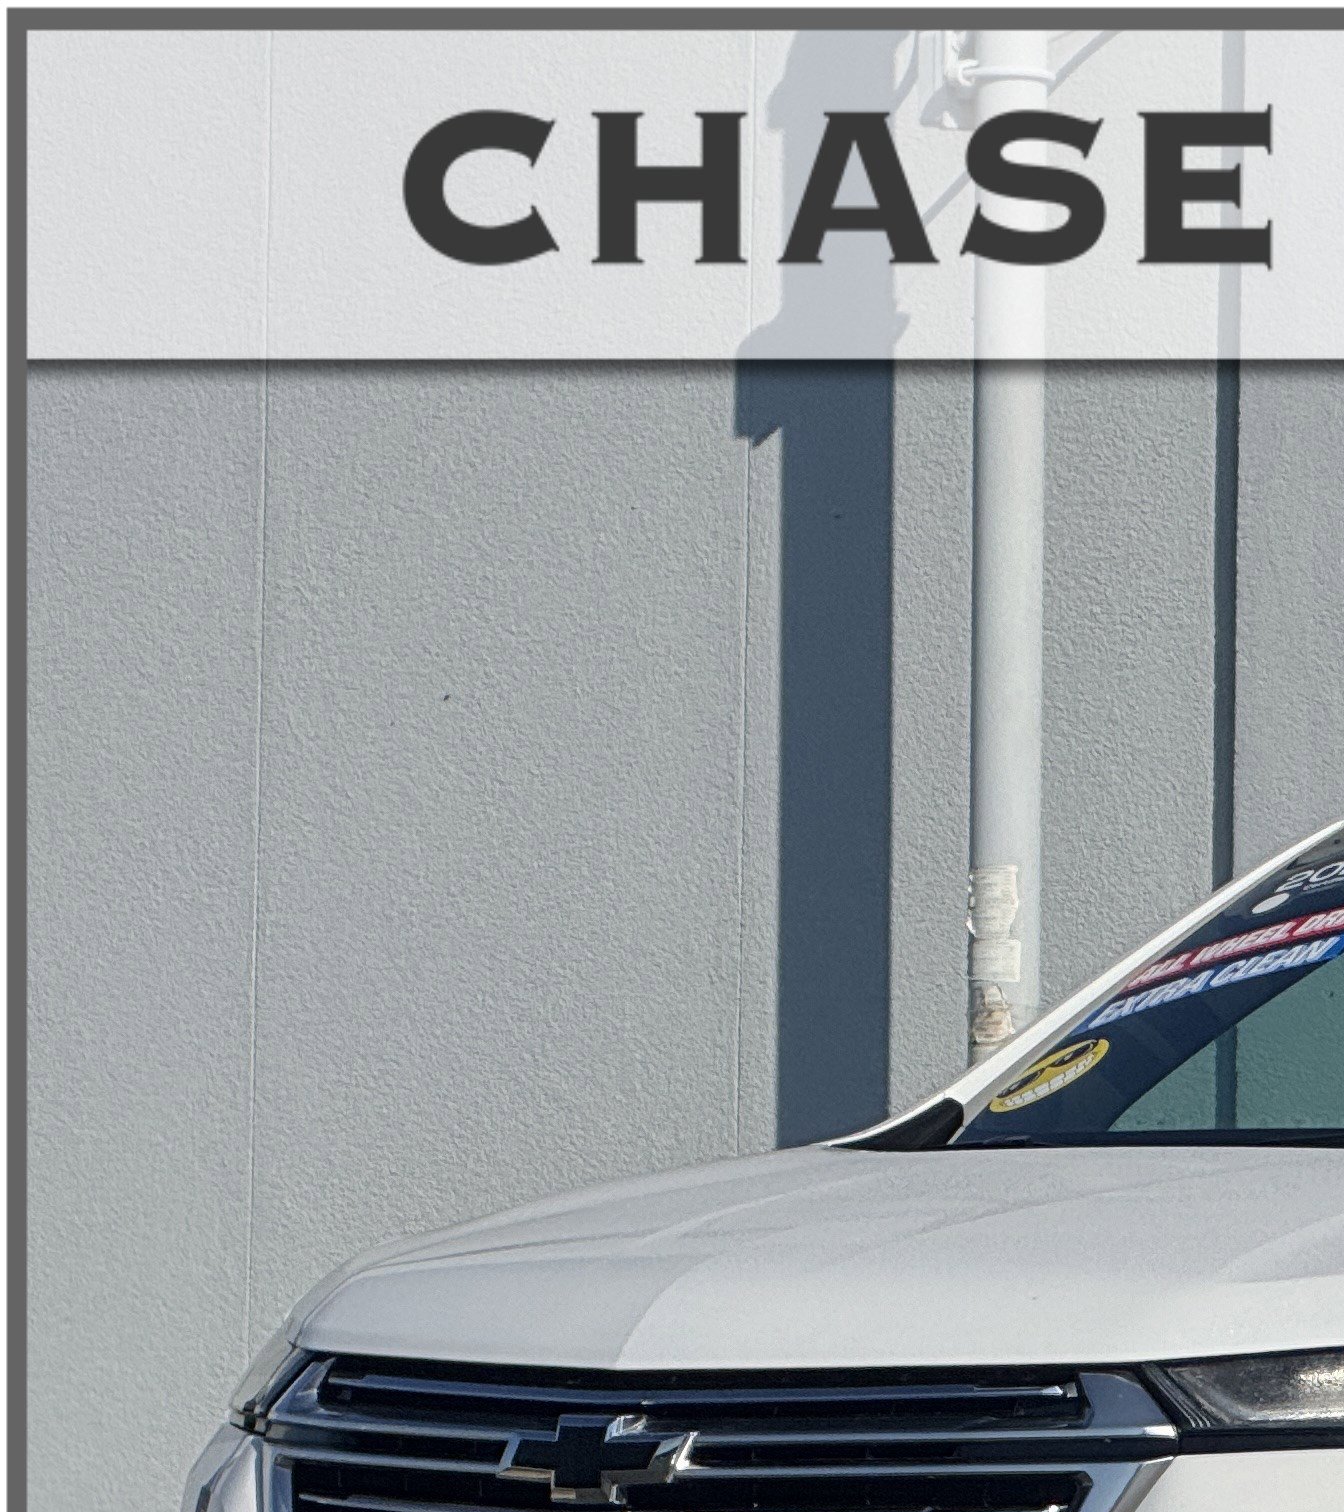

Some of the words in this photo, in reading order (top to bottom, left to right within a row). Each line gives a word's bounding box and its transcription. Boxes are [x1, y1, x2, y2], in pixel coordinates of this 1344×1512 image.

[1190, 921, 1299, 966] WHEEL
[1088, 970, 1216, 1028] EXTRA
[1209, 936, 1342, 986] CLEAN
